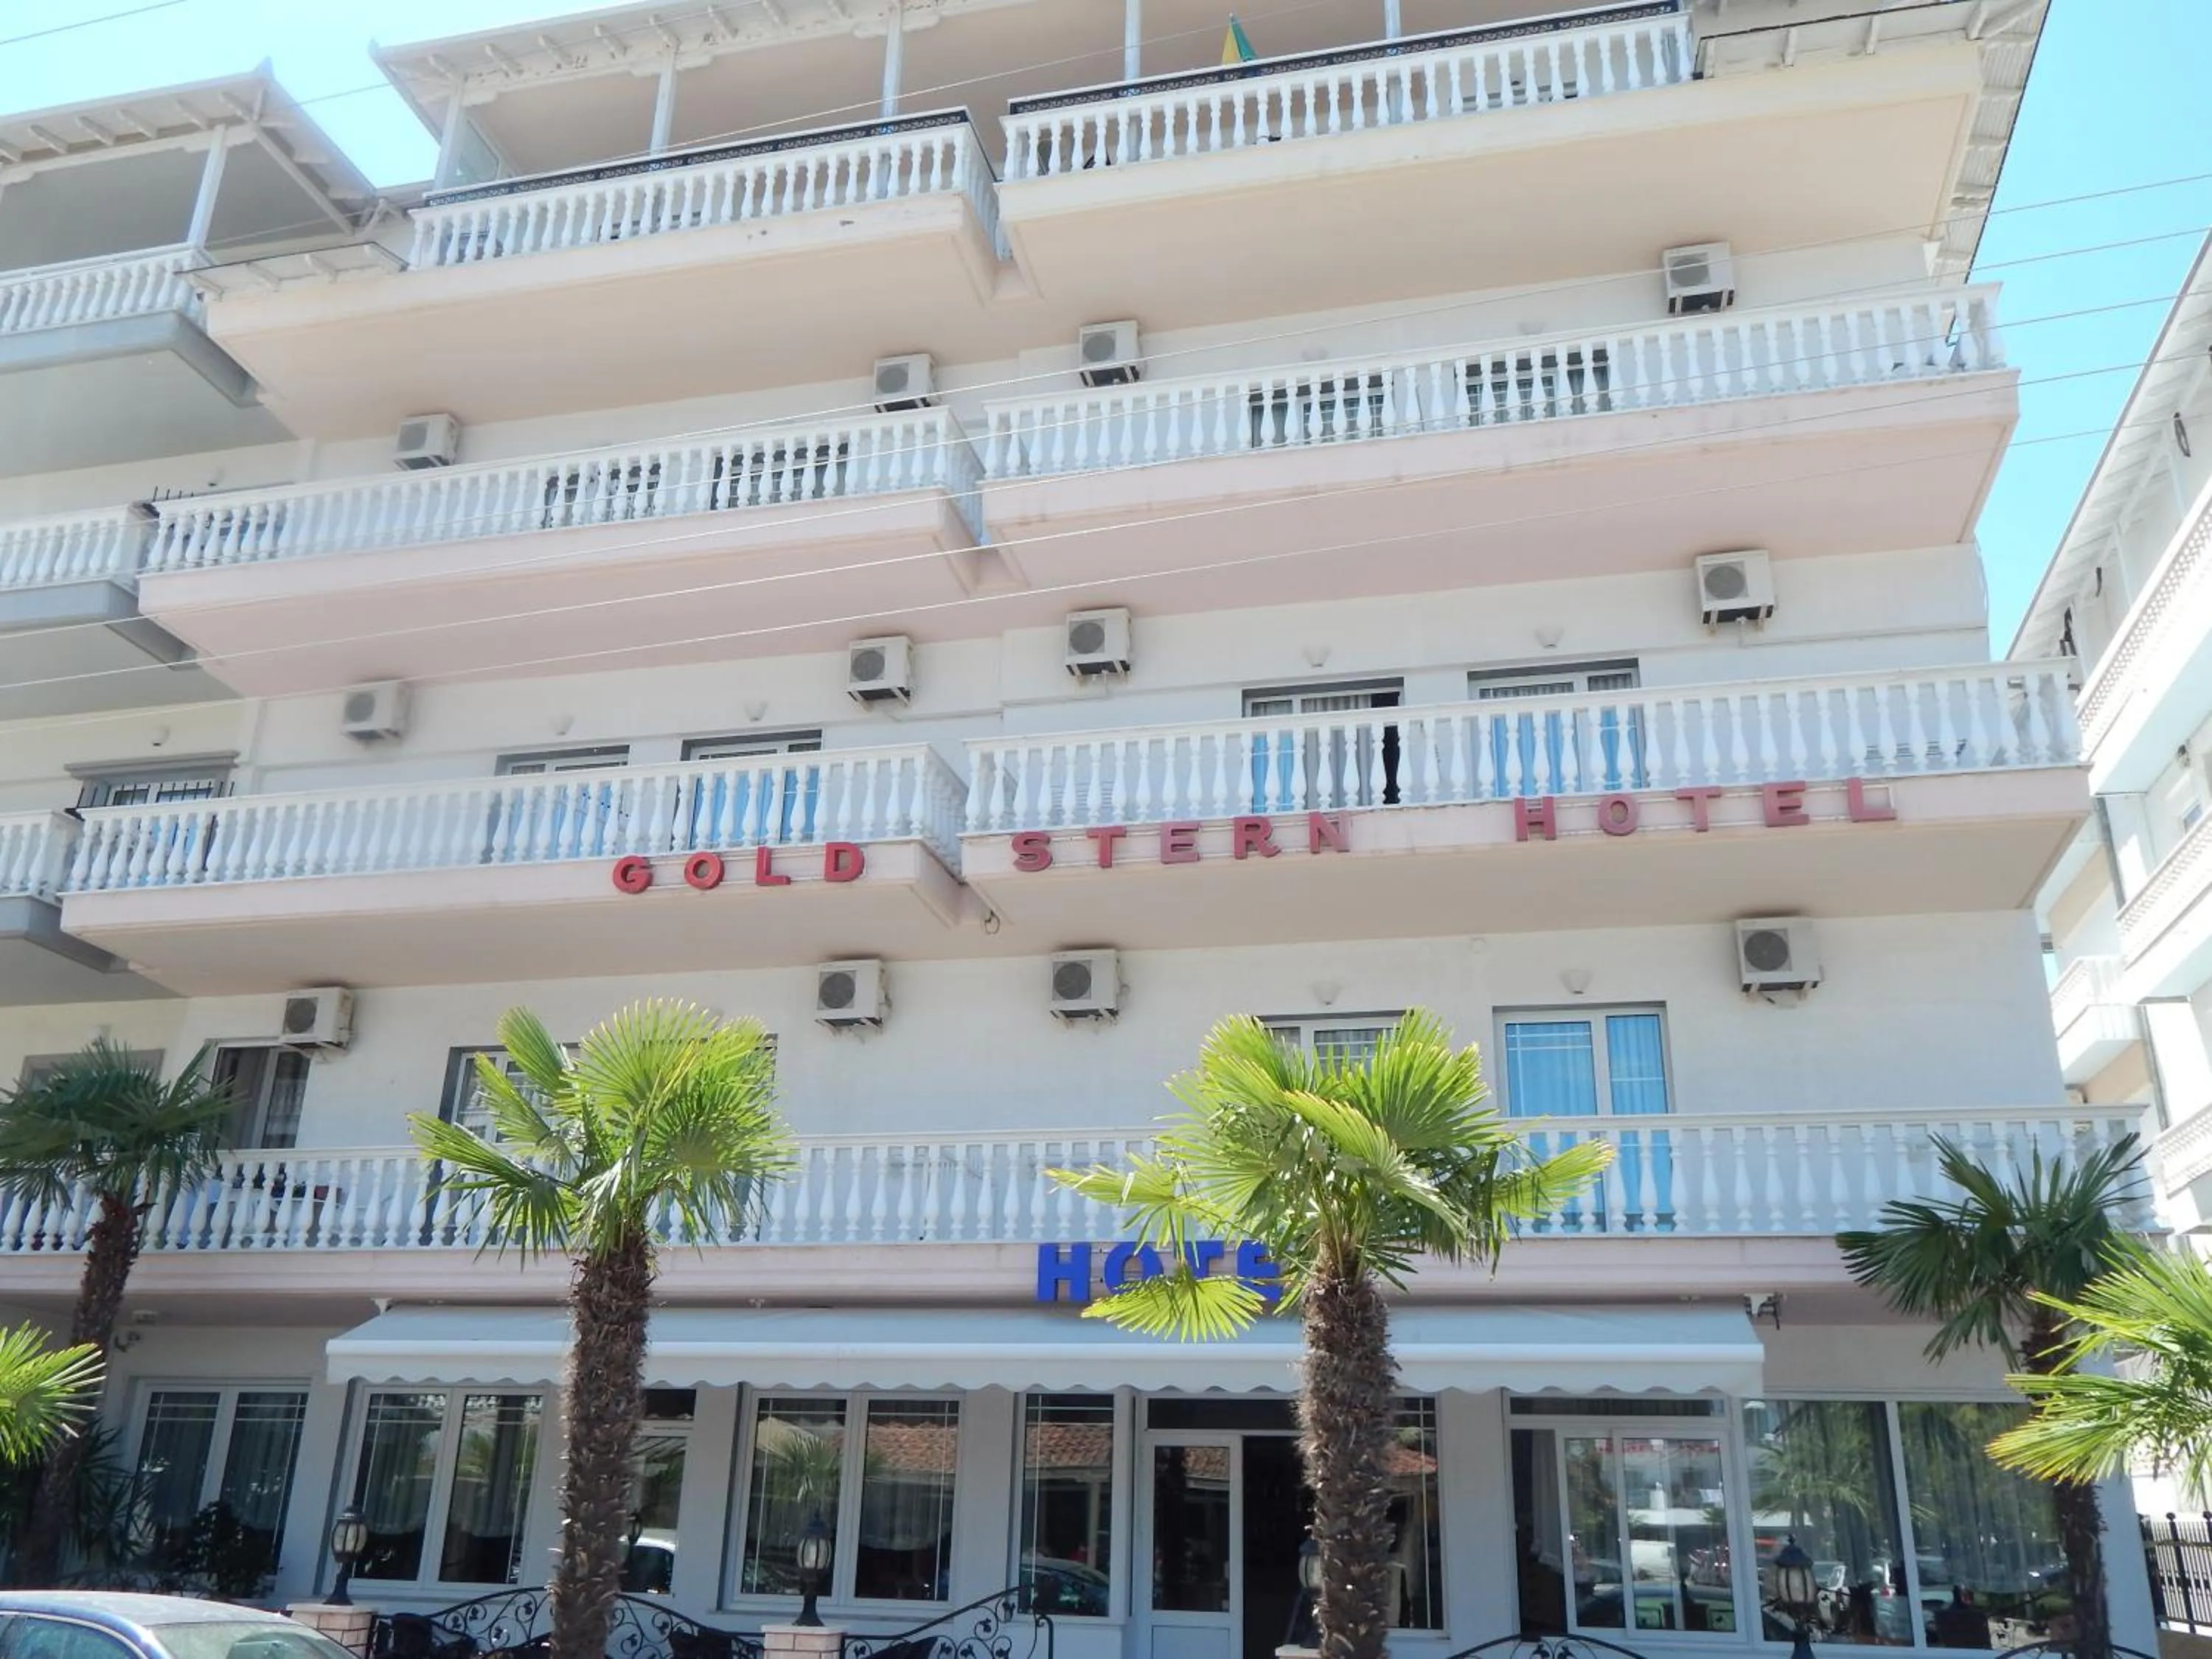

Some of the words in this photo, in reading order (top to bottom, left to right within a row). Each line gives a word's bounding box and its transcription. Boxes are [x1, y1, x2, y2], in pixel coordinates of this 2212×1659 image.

[612, 841, 863, 894] GOLD
[1011, 812, 1350, 872] STERN
[1514, 778, 1897, 841] HOTEL
[1037, 1241, 1284, 1302] HOTE
